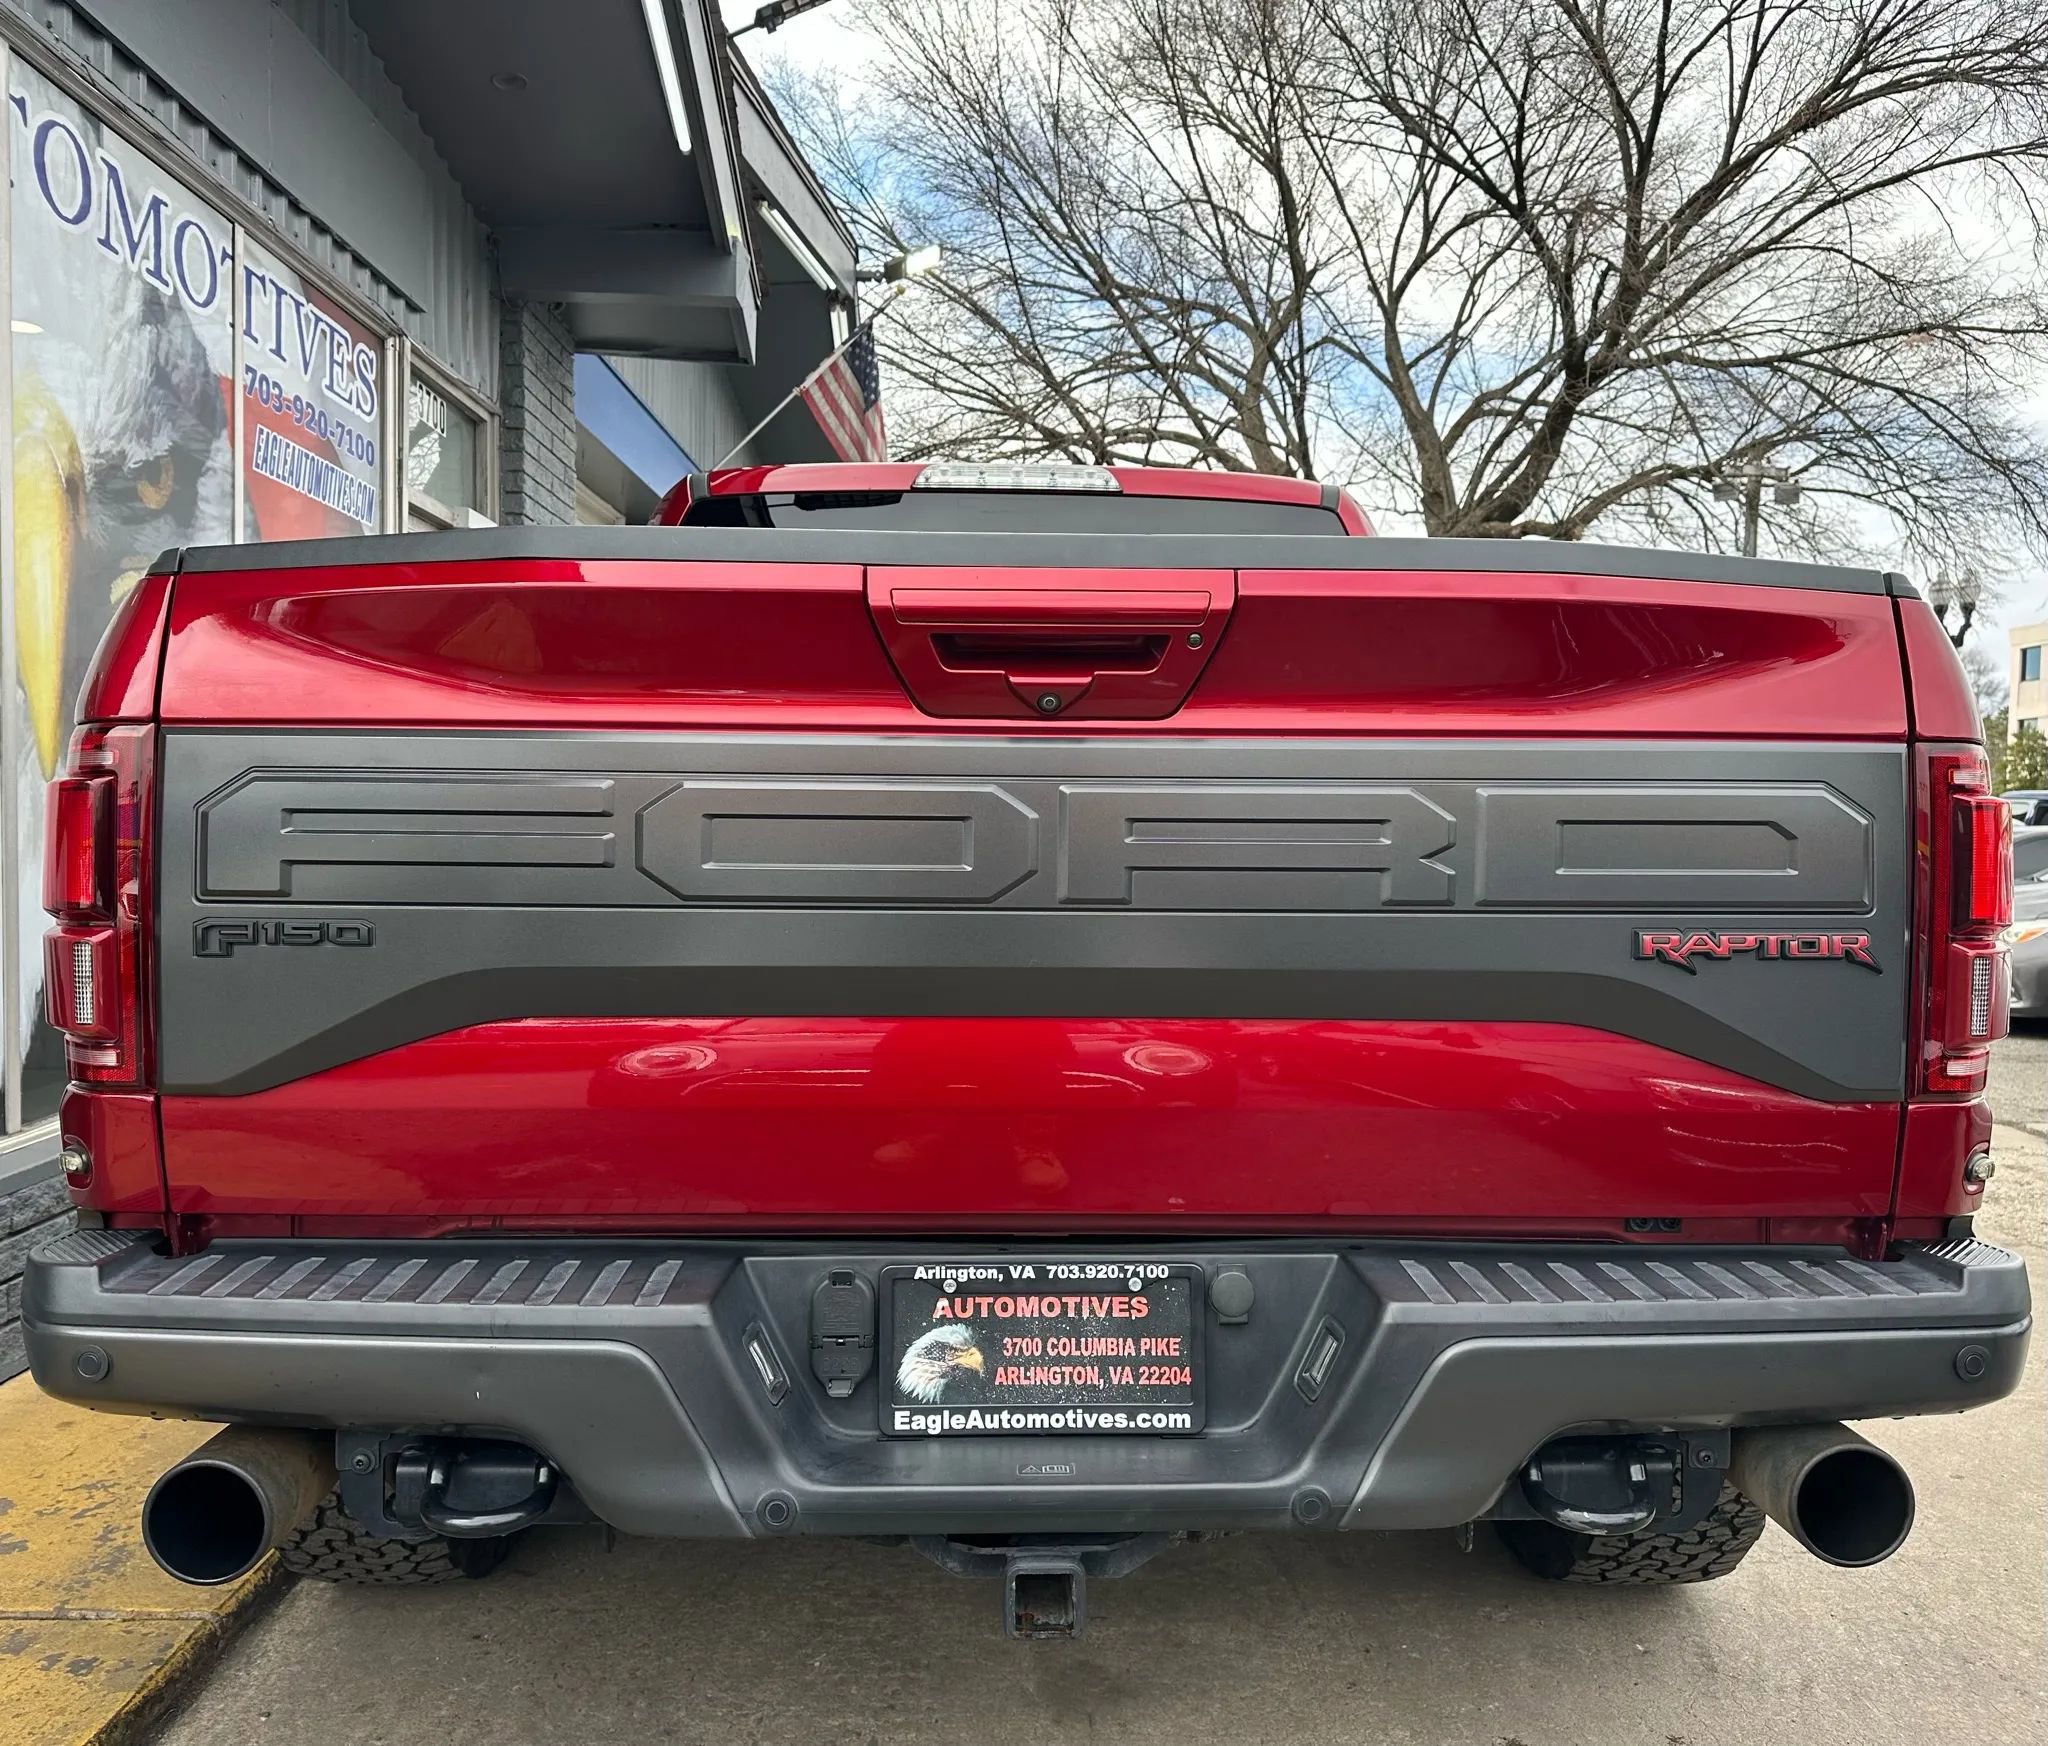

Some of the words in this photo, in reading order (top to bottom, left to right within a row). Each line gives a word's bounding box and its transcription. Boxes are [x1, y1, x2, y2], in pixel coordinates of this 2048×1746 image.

[9, 93, 377, 417] OMOTIVES
[245, 364, 376, 468] 703-920-7100
[418, 383, 446, 434] 3700
[256, 426, 376, 526] EAGLEAUTOMOTIVES.COM
[198, 774, 1873, 910] FORD
[1634, 928, 1883, 975] RAPTOR
[914, 1265, 1004, 1282] Arlington,
[1009, 1265, 1036, 1279] VA
[1048, 1264, 1169, 1279] 703.920.7100
[932, 1296, 1149, 1319] AUTOMOTIVES
[1002, 1337, 1042, 1357] 3700
[1047, 1337, 1136, 1357] COLUMBIA
[1140, 1337, 1181, 1357] PIKE
[994, 1366, 1104, 1387] ARLINGTON,
[1110, 1366, 1133, 1386] VA
[1138, 1366, 1192, 1386] 22204
[894, 1409, 1191, 1435] EagleAutomotives.com
